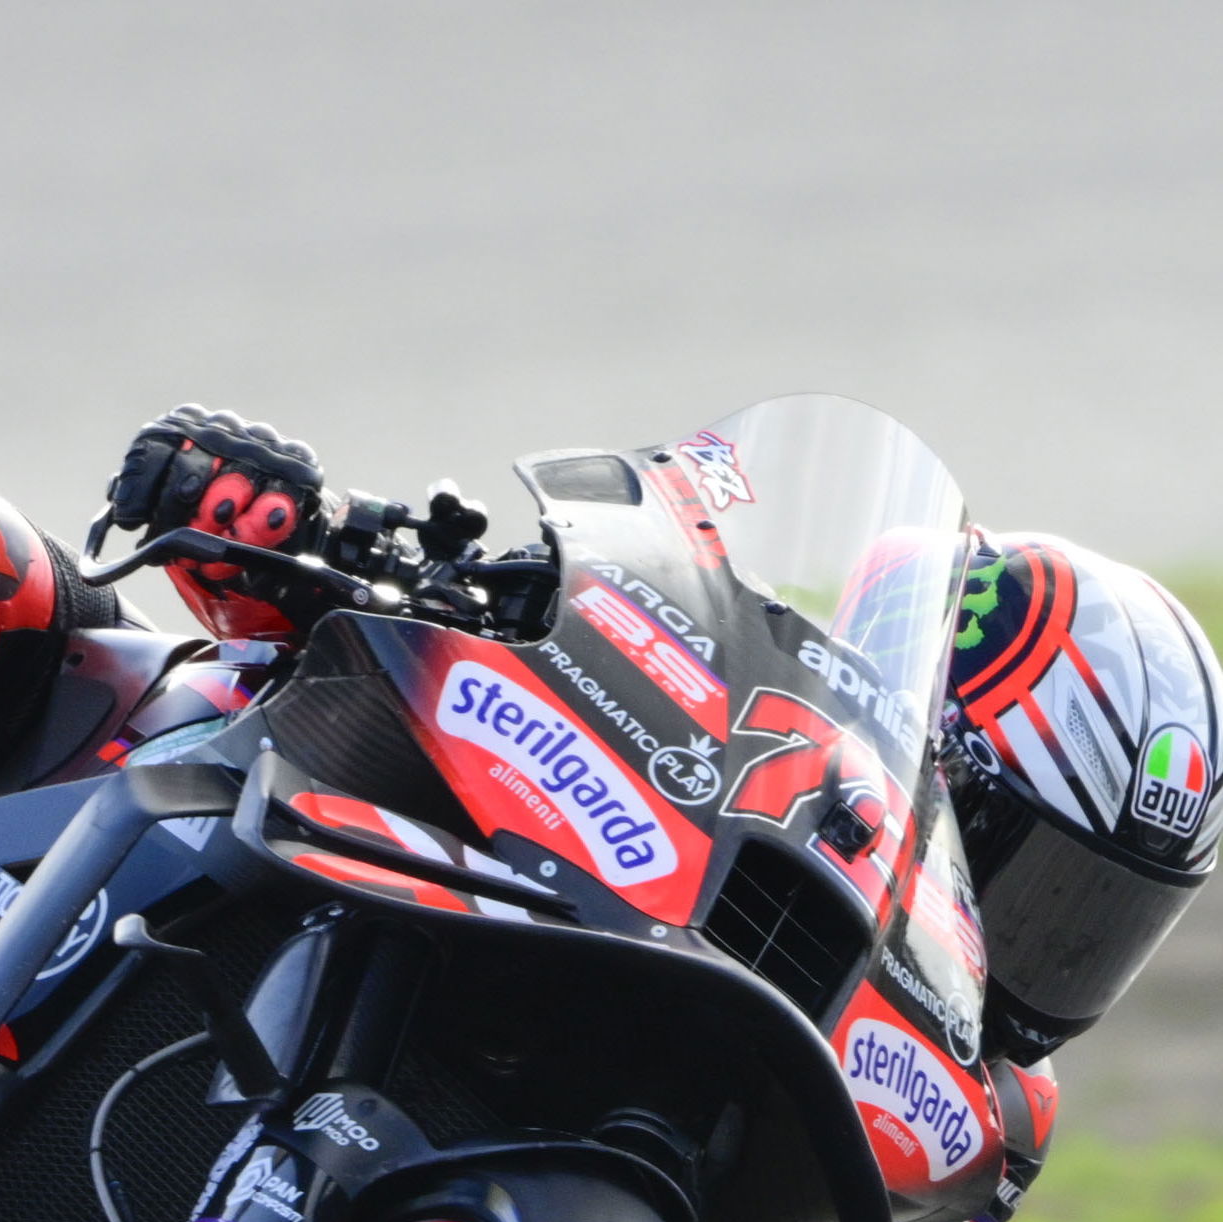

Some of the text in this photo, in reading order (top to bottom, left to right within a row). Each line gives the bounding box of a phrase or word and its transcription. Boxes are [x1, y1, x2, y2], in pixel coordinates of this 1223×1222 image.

[575, 586, 717, 702] BS
[591, 564, 715, 661] ARGA
[539, 641, 659, 752] PRAGMATIC
[797, 639, 919, 767] aprilia
[451, 676, 655, 870] sterilgarda
[489, 762, 566, 831] alimenti
[657, 753, 712, 796] PLAY
[881, 945, 947, 1022] PRAGMATIC
[333, 1113, 380, 1151] MOD
[851, 1033, 973, 1168] sterilgarda
[873, 1112, 918, 1158] alimenti
[261, 1175, 305, 1203] PAN
